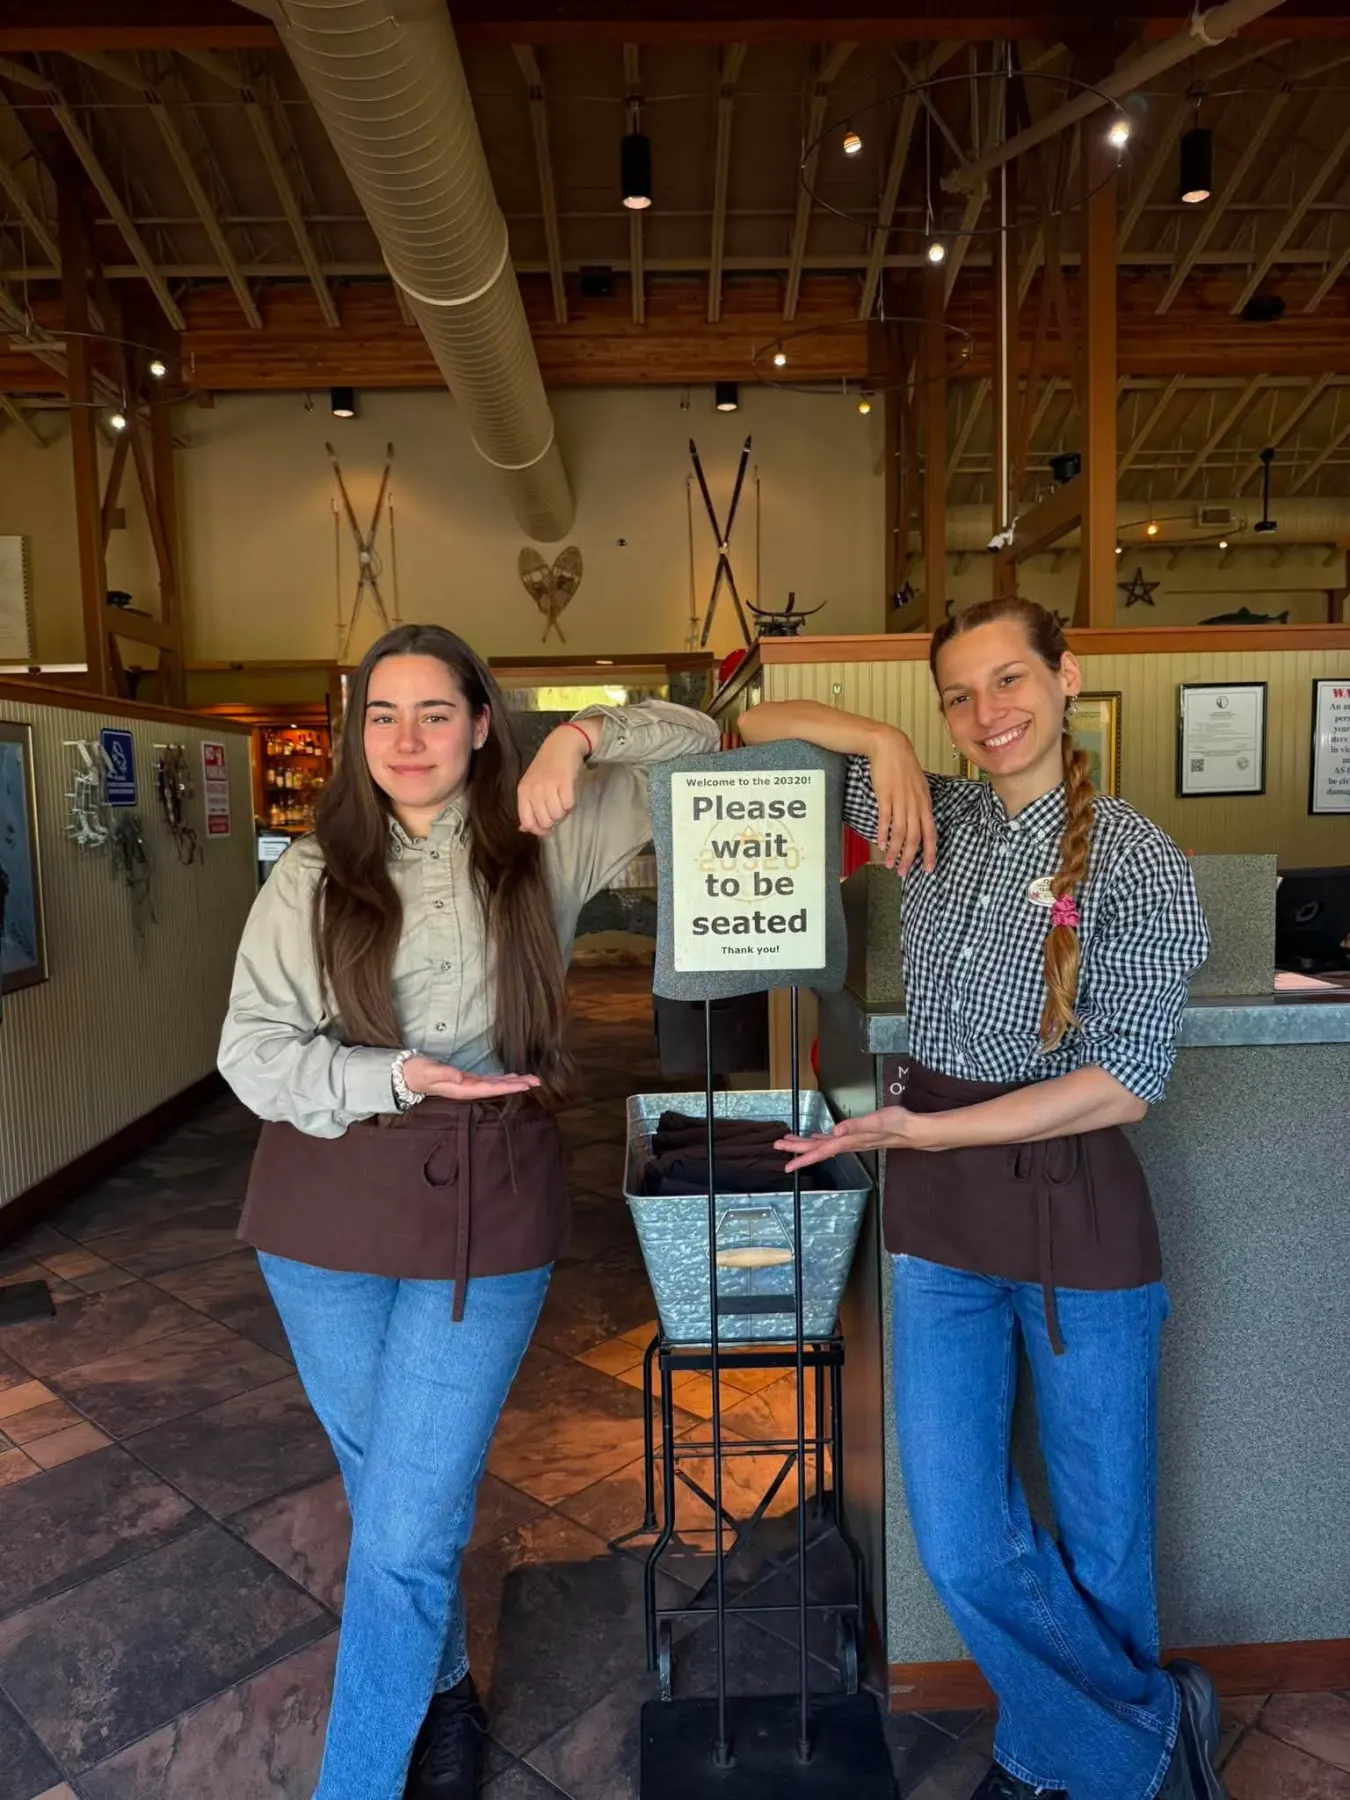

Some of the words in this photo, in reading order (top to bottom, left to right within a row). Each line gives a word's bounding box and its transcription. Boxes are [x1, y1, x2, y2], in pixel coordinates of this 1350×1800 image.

[686, 778, 735, 787] Welcome
[738, 778, 750, 787] to
[752, 777, 771, 786] the
[774, 776, 812, 786] 20320!
[693, 795, 807, 821] Please
[712, 833, 788, 859] wait
[705, 873, 740, 897] to
[753, 872, 794, 896] be
[692, 908, 807, 935] seated
[721, 945, 754, 955] Thank
[756, 945, 780, 955] you!
